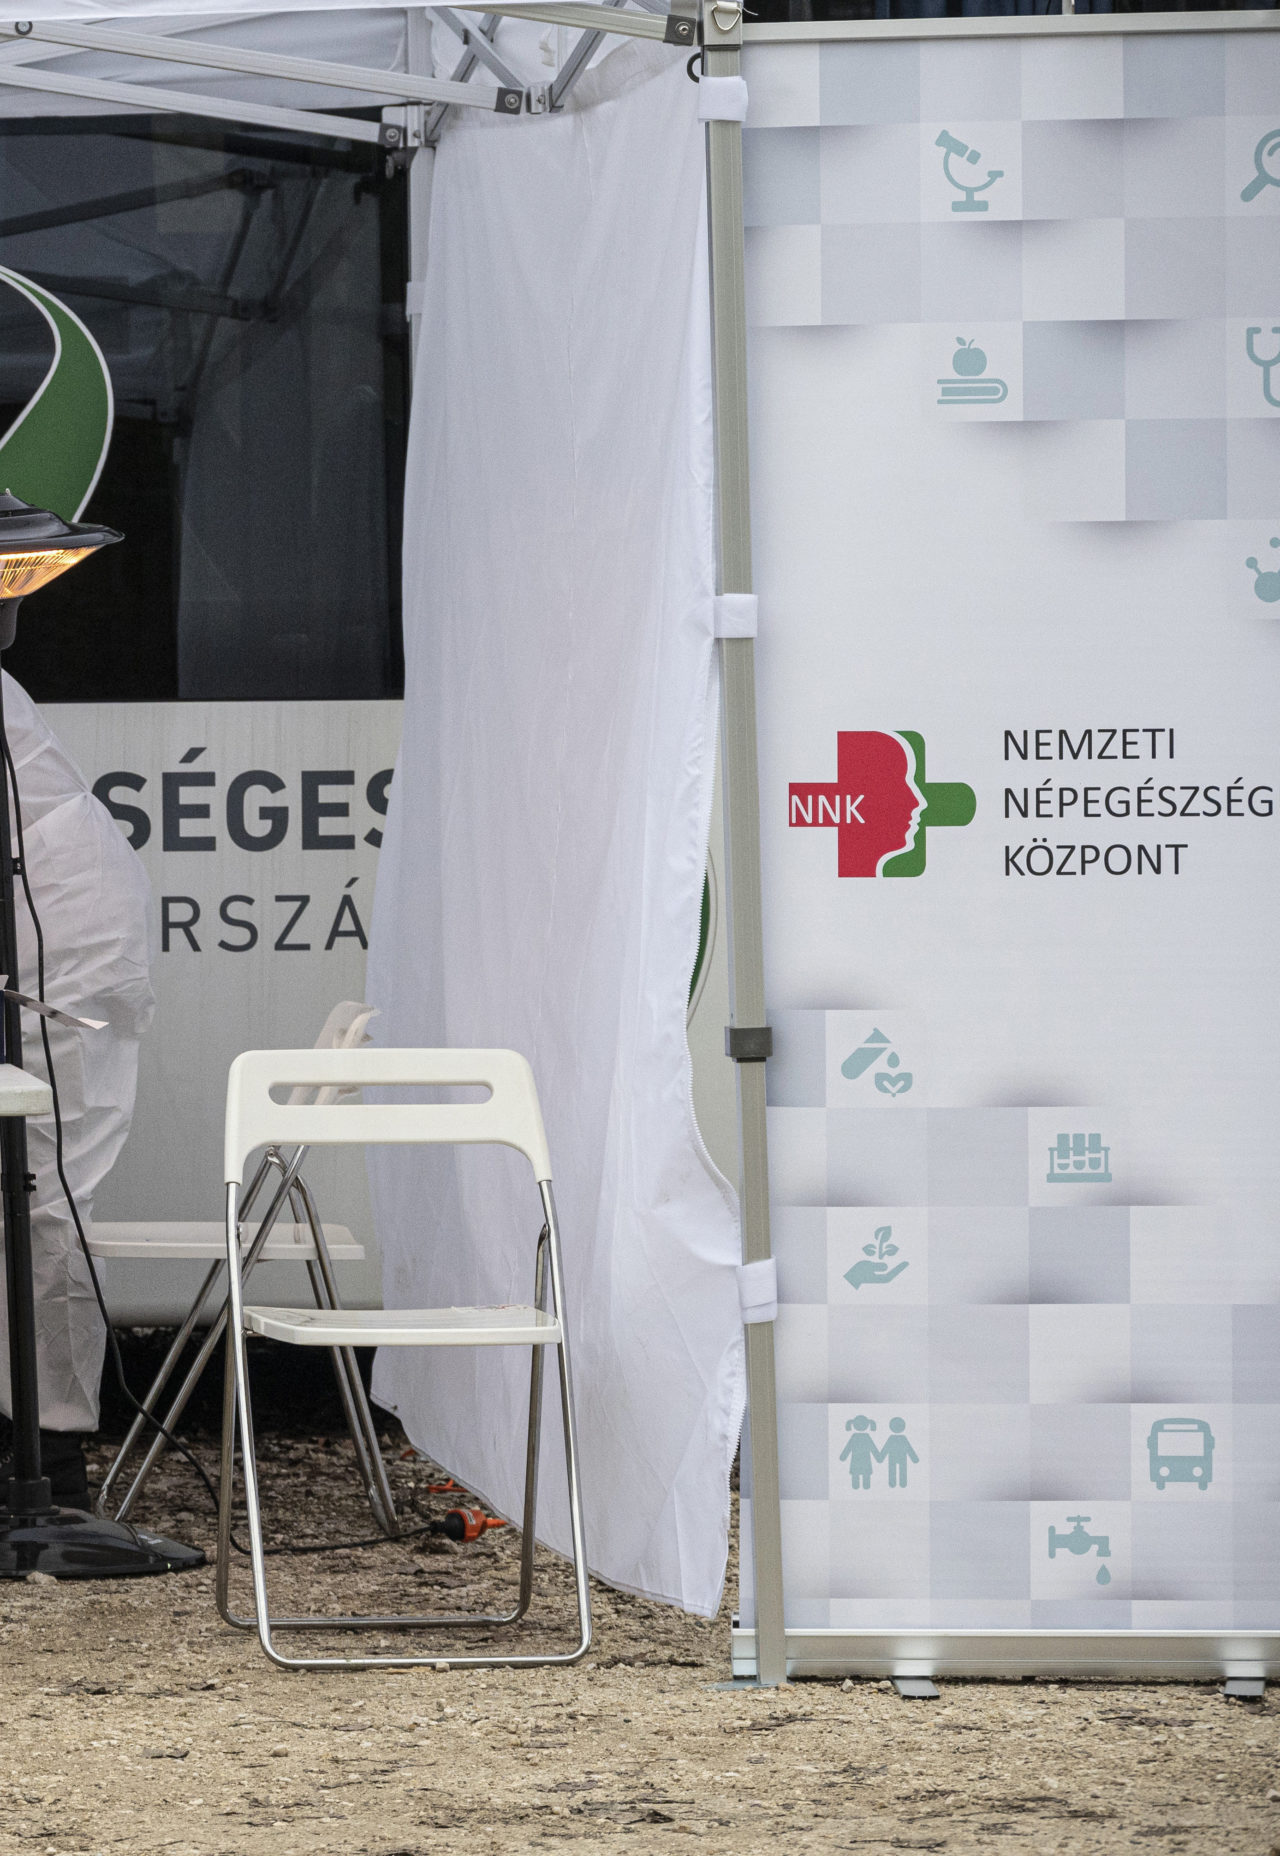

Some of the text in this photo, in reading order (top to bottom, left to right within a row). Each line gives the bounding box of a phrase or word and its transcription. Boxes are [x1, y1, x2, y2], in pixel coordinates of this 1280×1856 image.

[1004, 728, 1175, 761] NEMZETI
[792, 795, 865, 824] NNK
[1004, 777, 1274, 819] NÉPEGÉSZSÉG
[1004, 838, 1189, 877] KÖZPONT
